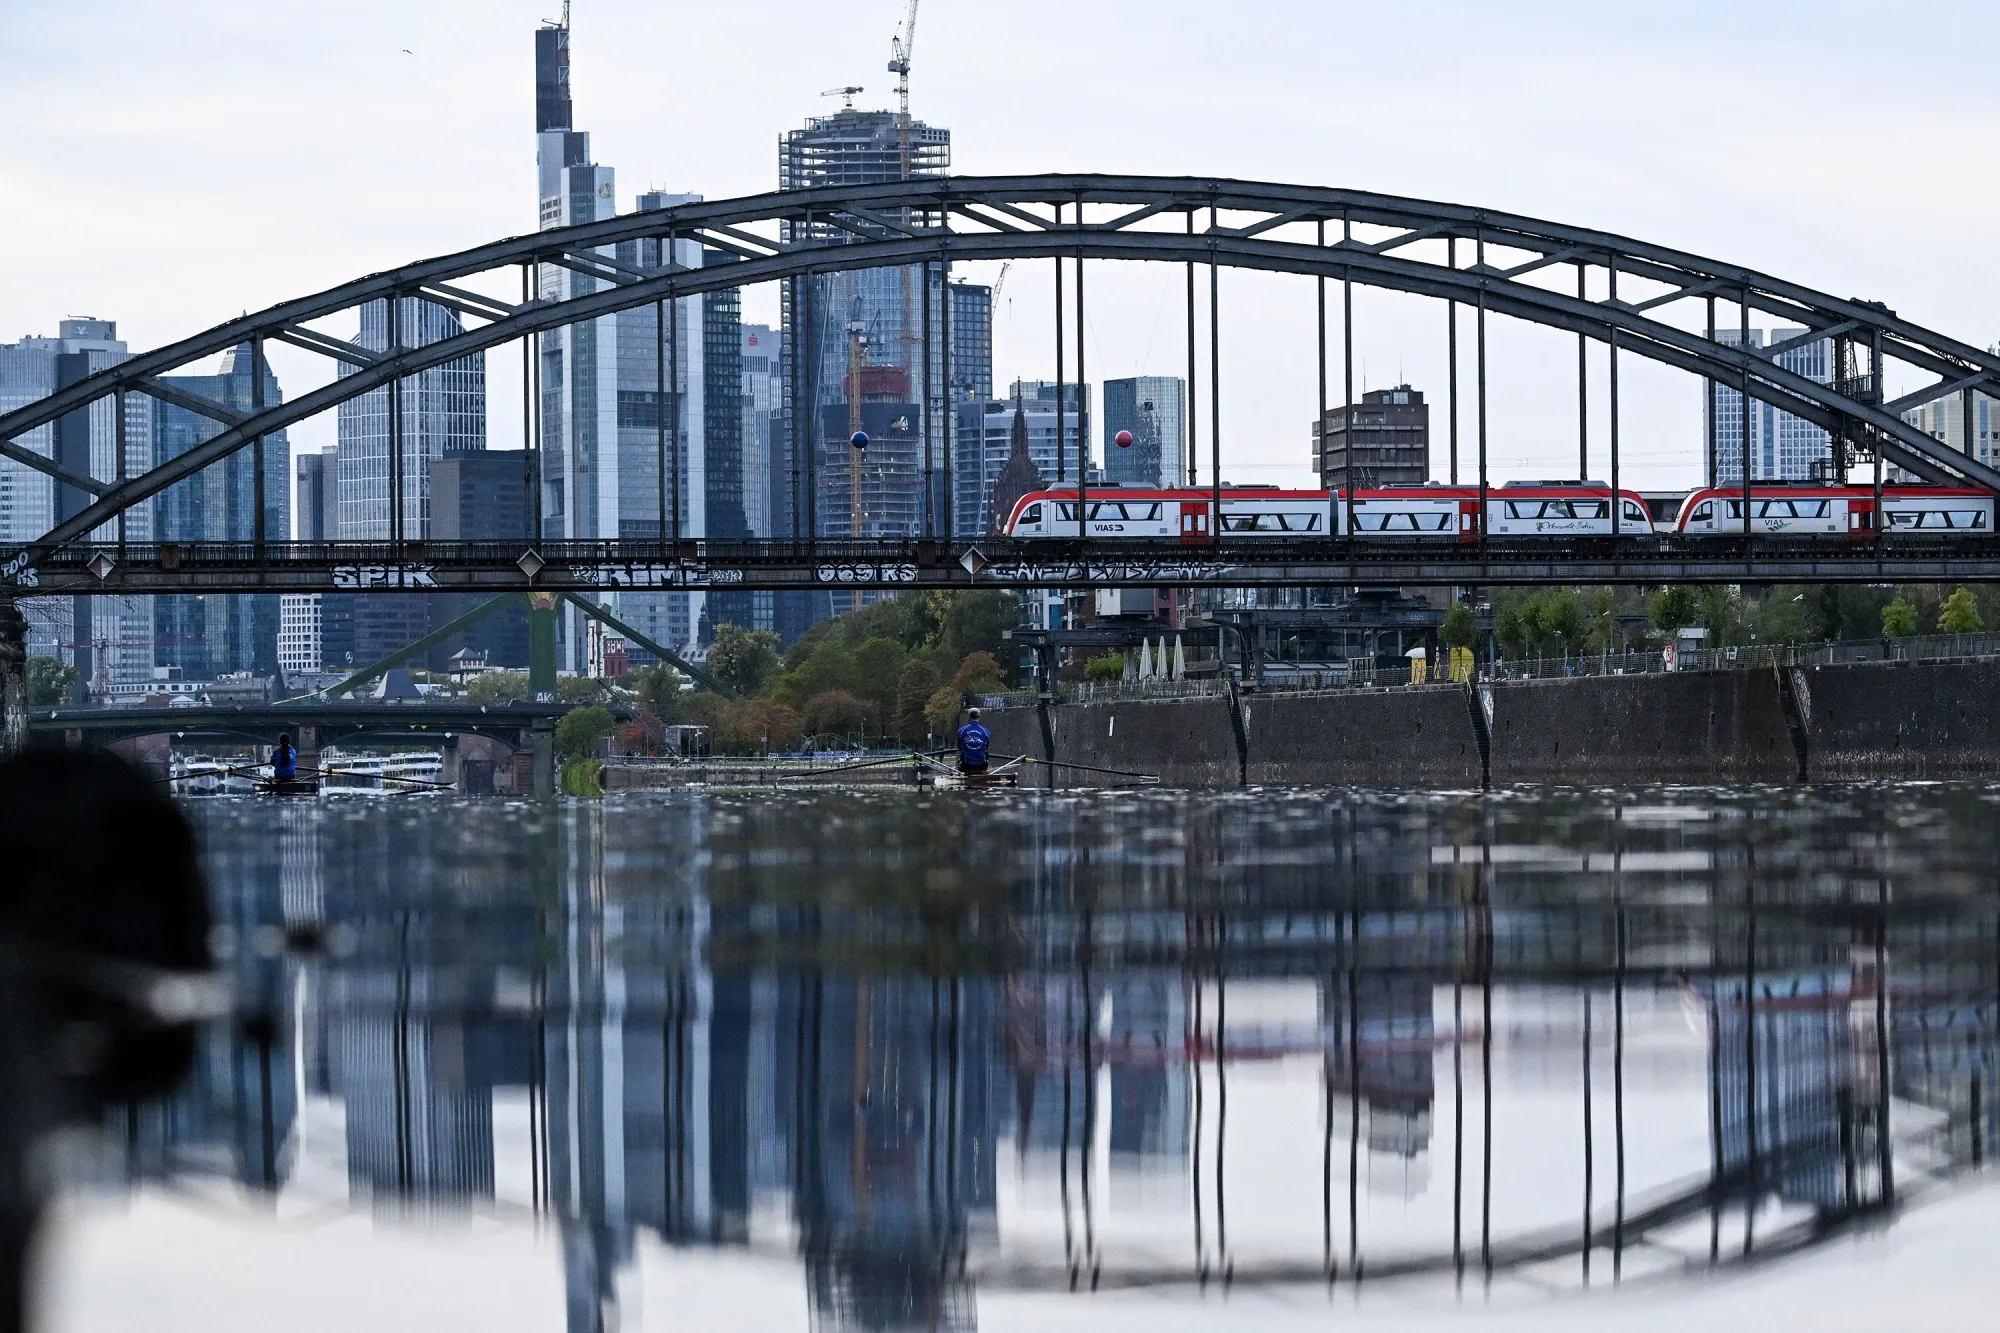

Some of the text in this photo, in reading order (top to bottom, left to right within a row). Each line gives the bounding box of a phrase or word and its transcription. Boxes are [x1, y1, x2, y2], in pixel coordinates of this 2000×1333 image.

[1094, 524, 1114, 532] VIAS
[331, 563, 440, 588] SPIK
[1233, 613, 1240, 623] 11
